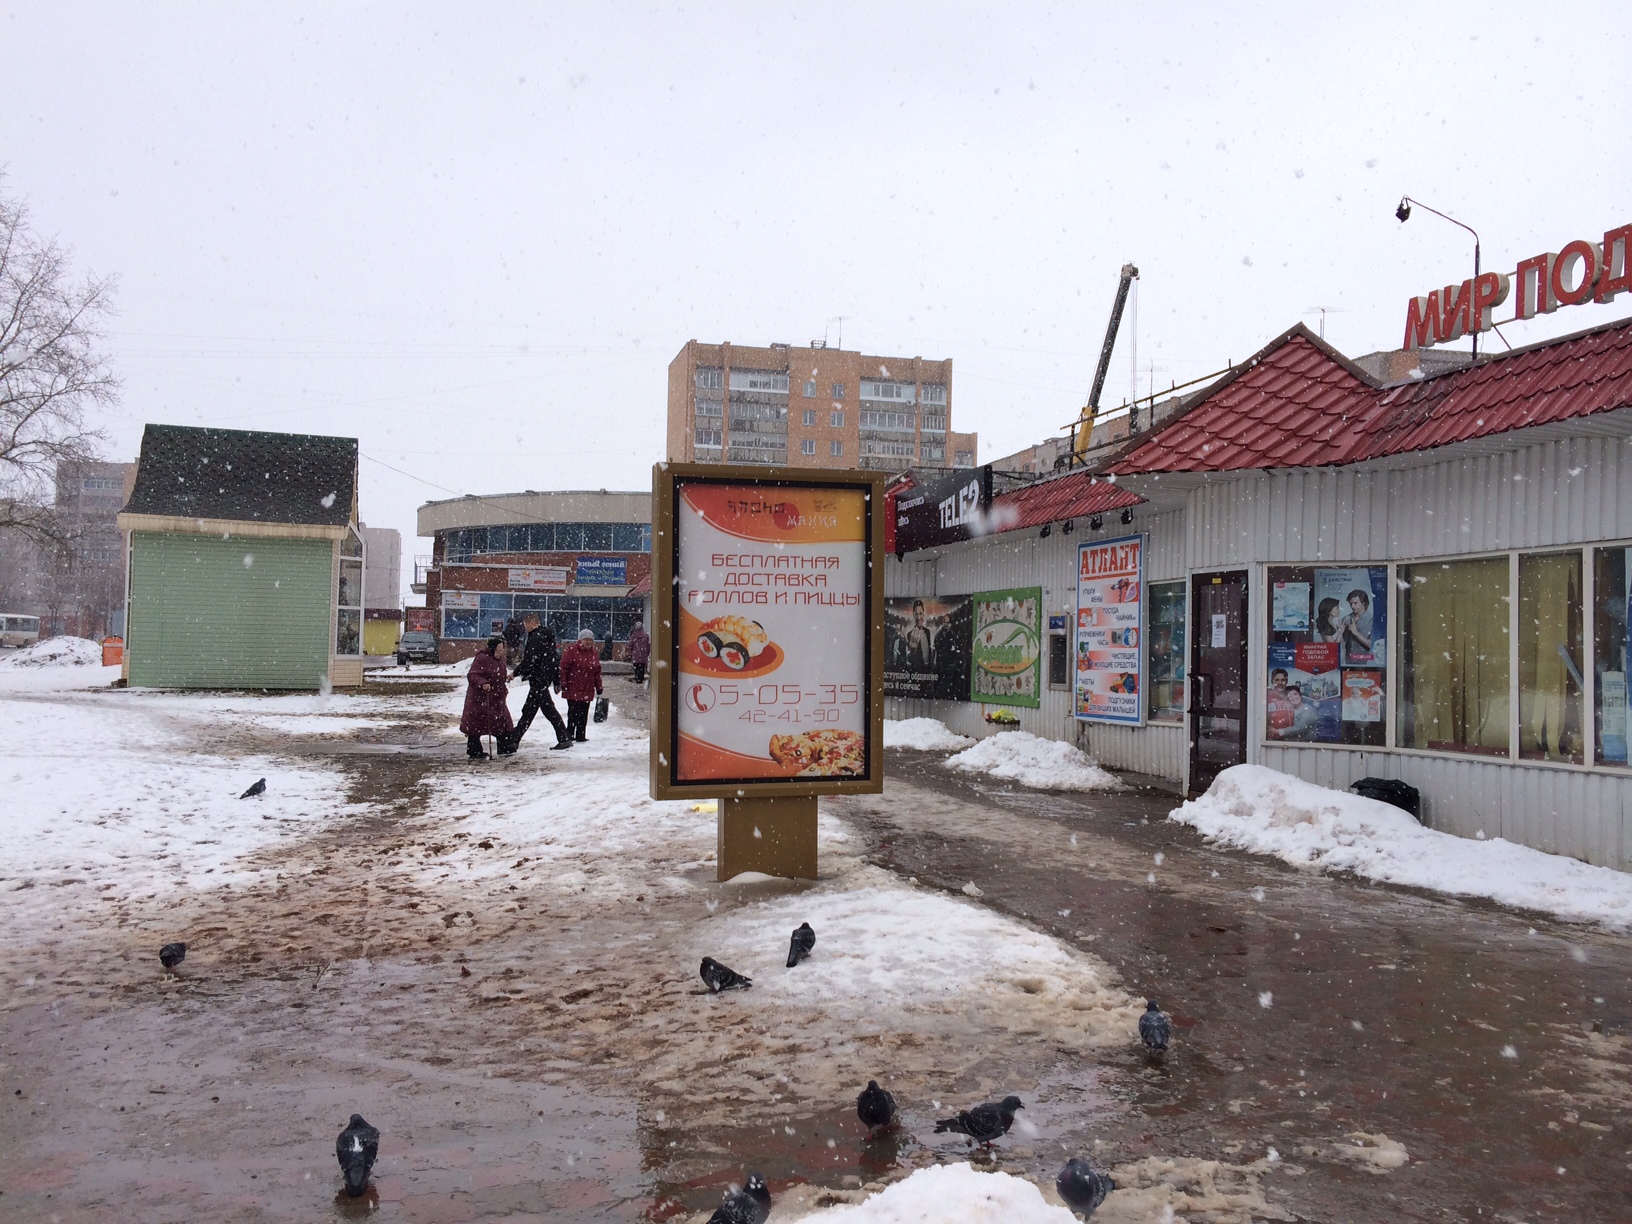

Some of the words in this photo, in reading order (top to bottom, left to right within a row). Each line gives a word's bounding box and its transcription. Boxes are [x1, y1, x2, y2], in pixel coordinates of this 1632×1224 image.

[1403, 272, 1509, 350] МИР
[727, 500, 785, 514] ЯПОНО
[938, 479, 980, 529] TELE2
[786, 515, 837, 528] МАНИЯ
[711, 553, 840, 569] БЕСПЛАТНАЯ
[1080, 543, 1139, 575] АТЛАНТ
[724, 572, 827, 587] ДОСТАВКА
[775, 591, 788, 604] И
[795, 592, 861, 607] ПИЦЦЫ
[1114, 661, 1137, 669] СРЕДСТВА
[911, 672, 939, 682] общение
[719, 684, 859, 705] 5-05-35
[738, 709, 840, 723] 42-41-90
